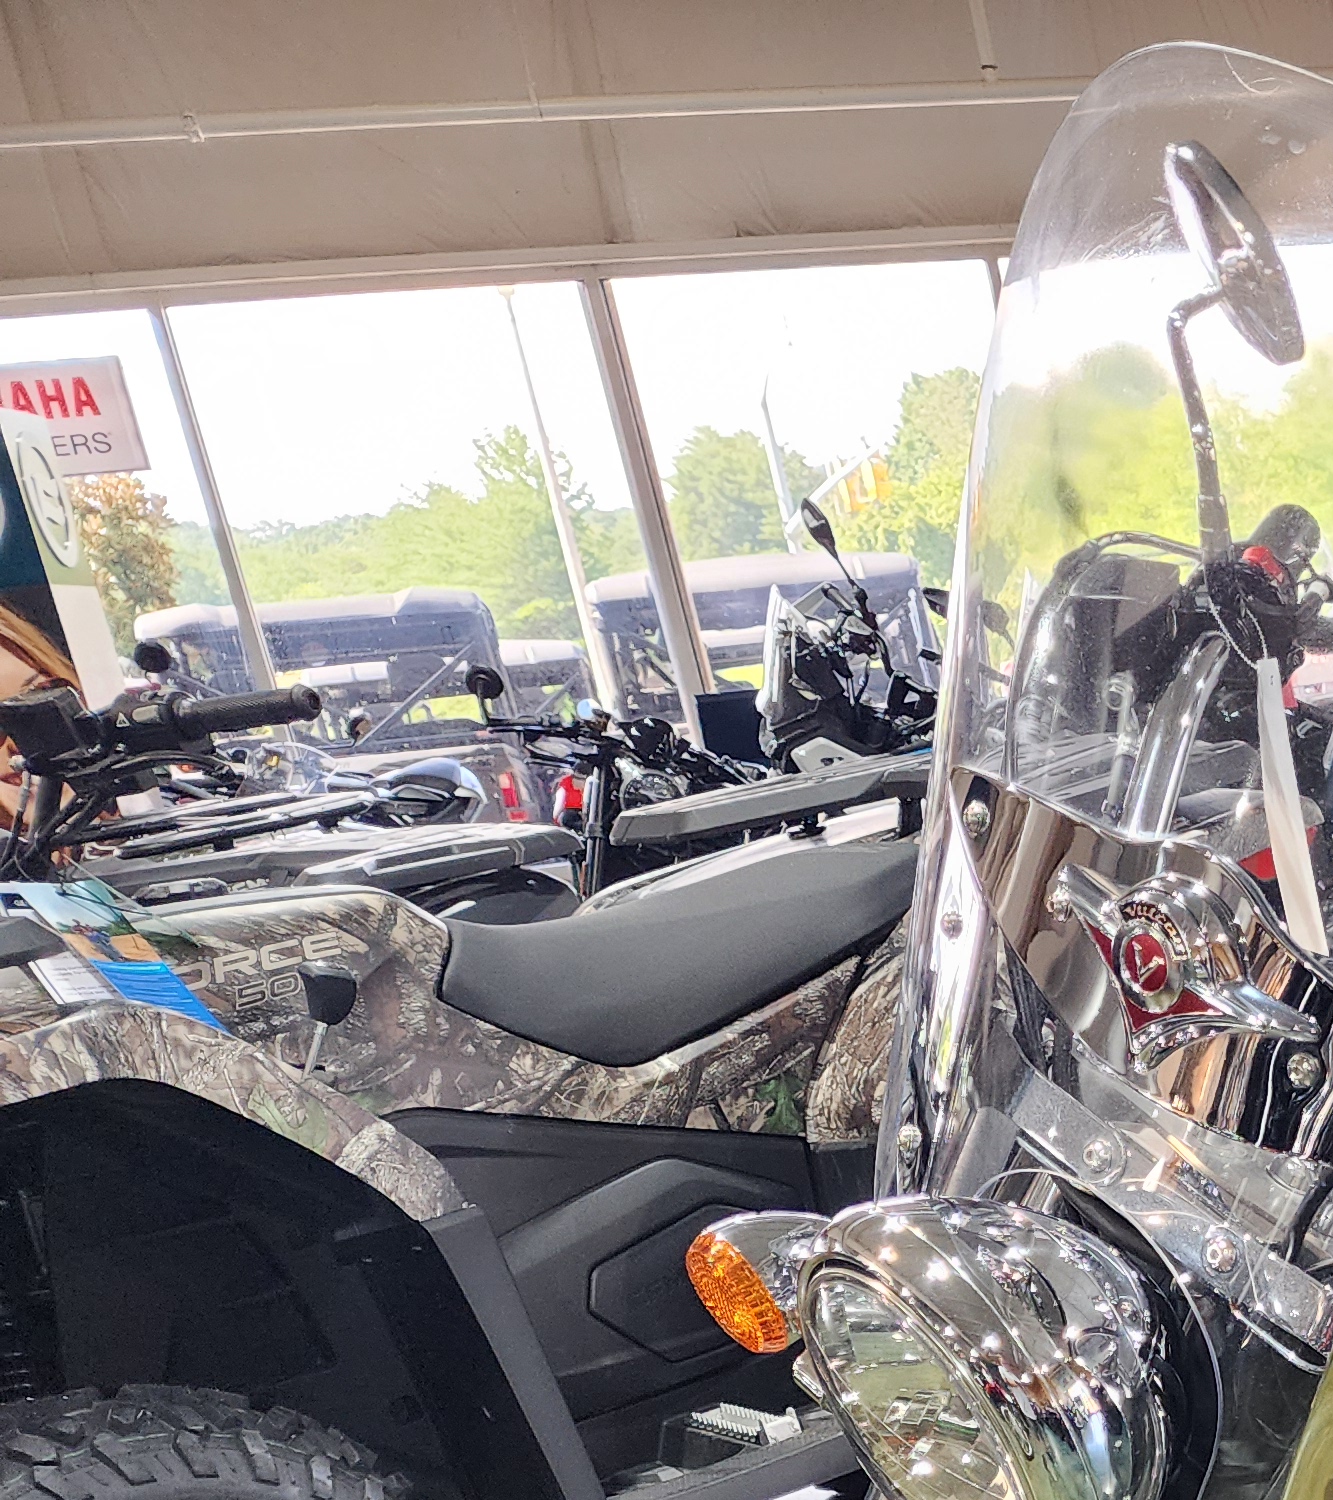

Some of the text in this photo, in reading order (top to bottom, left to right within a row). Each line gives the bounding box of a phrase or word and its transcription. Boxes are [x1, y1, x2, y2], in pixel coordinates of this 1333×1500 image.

[10, 377, 101, 419] AHA
[52, 432, 112, 457] ERS
[174, 932, 342, 991] ORCE
